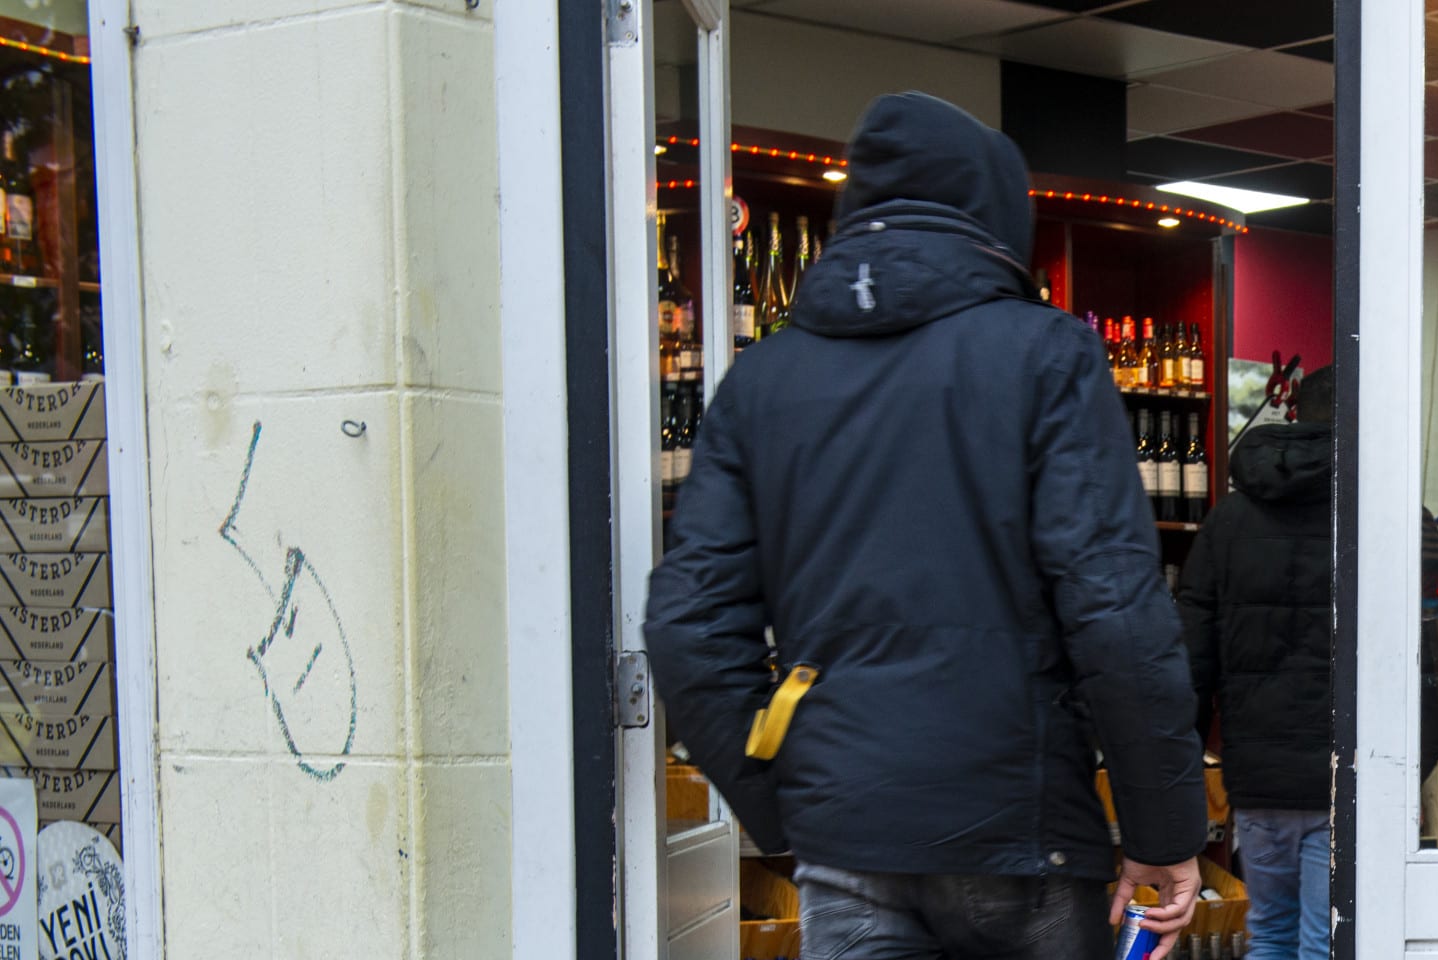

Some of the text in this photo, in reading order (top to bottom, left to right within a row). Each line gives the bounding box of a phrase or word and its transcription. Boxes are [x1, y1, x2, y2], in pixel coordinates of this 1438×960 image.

[29, 533, 63, 541] NEDERLAND
[30, 589, 65, 598] NEDERLAND
[30, 641, 65, 650] NEDERLAND
[36, 749, 70, 757] NEDERLAND
[42, 801, 76, 810] NEDERLAND
[0, 944, 21, 960] LEN
